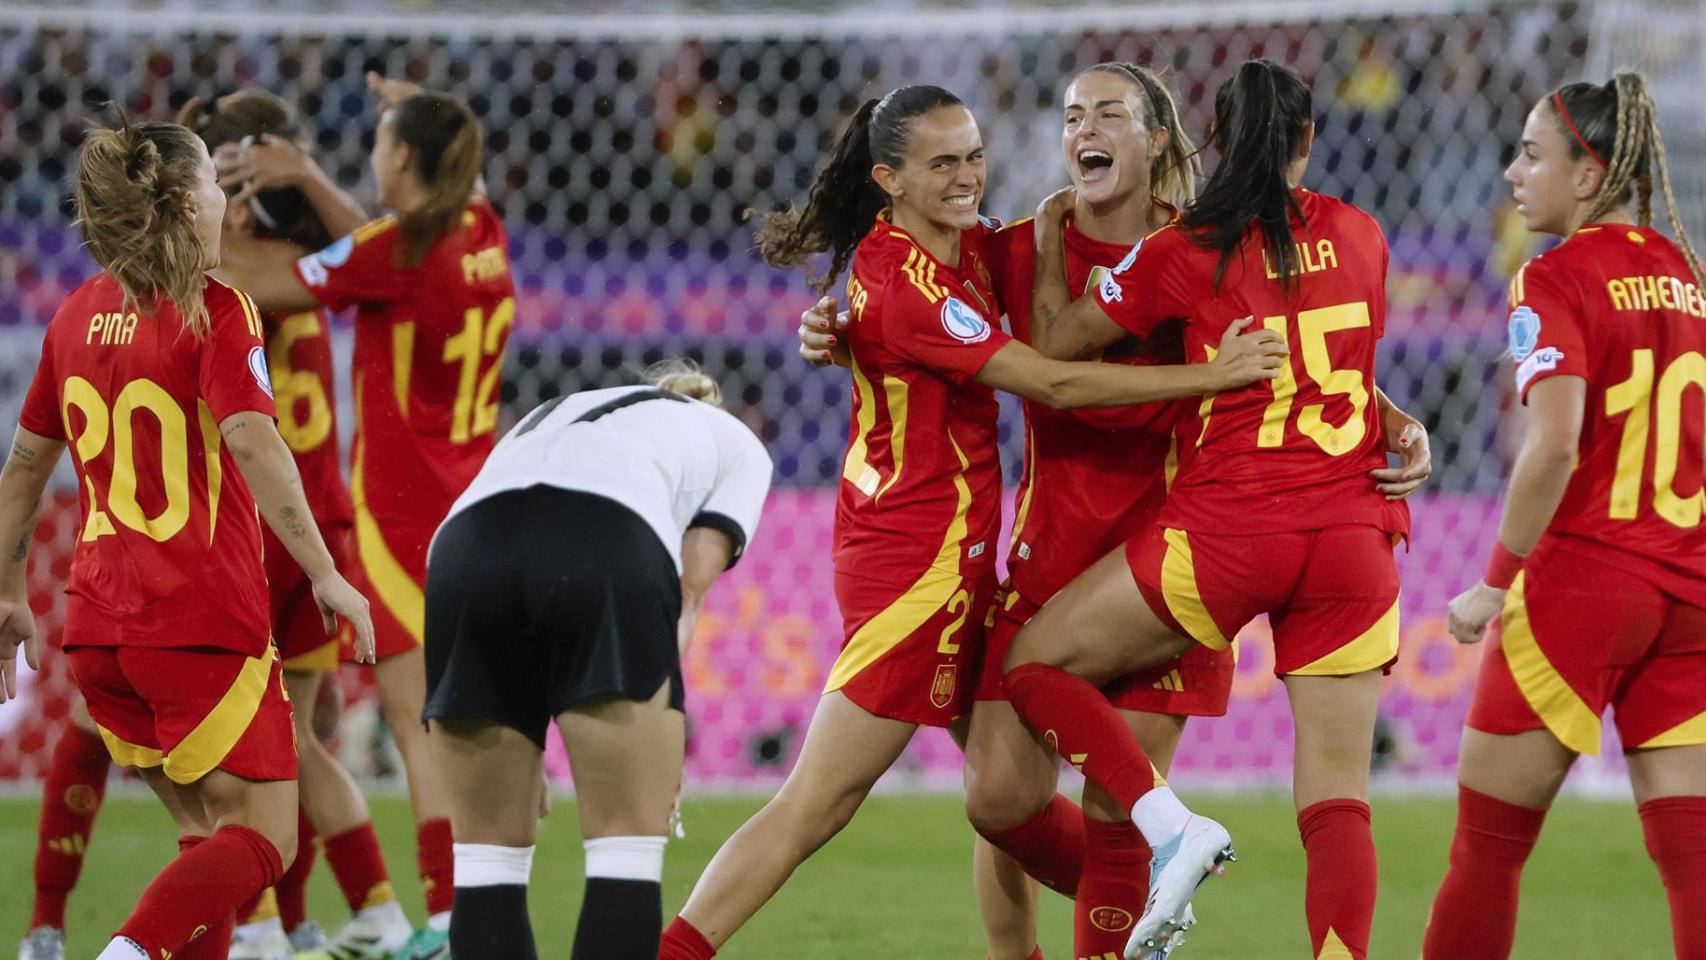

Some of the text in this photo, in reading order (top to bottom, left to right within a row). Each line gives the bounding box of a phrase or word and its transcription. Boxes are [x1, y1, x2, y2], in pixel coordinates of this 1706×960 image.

[86, 312, 138, 345] PINA
[1262, 239, 1338, 279] LILA
[442, 298, 517, 444] 12
[1257, 301, 1371, 457] 15
[1605, 348, 1706, 528] 10
[63, 375, 190, 543] 20
